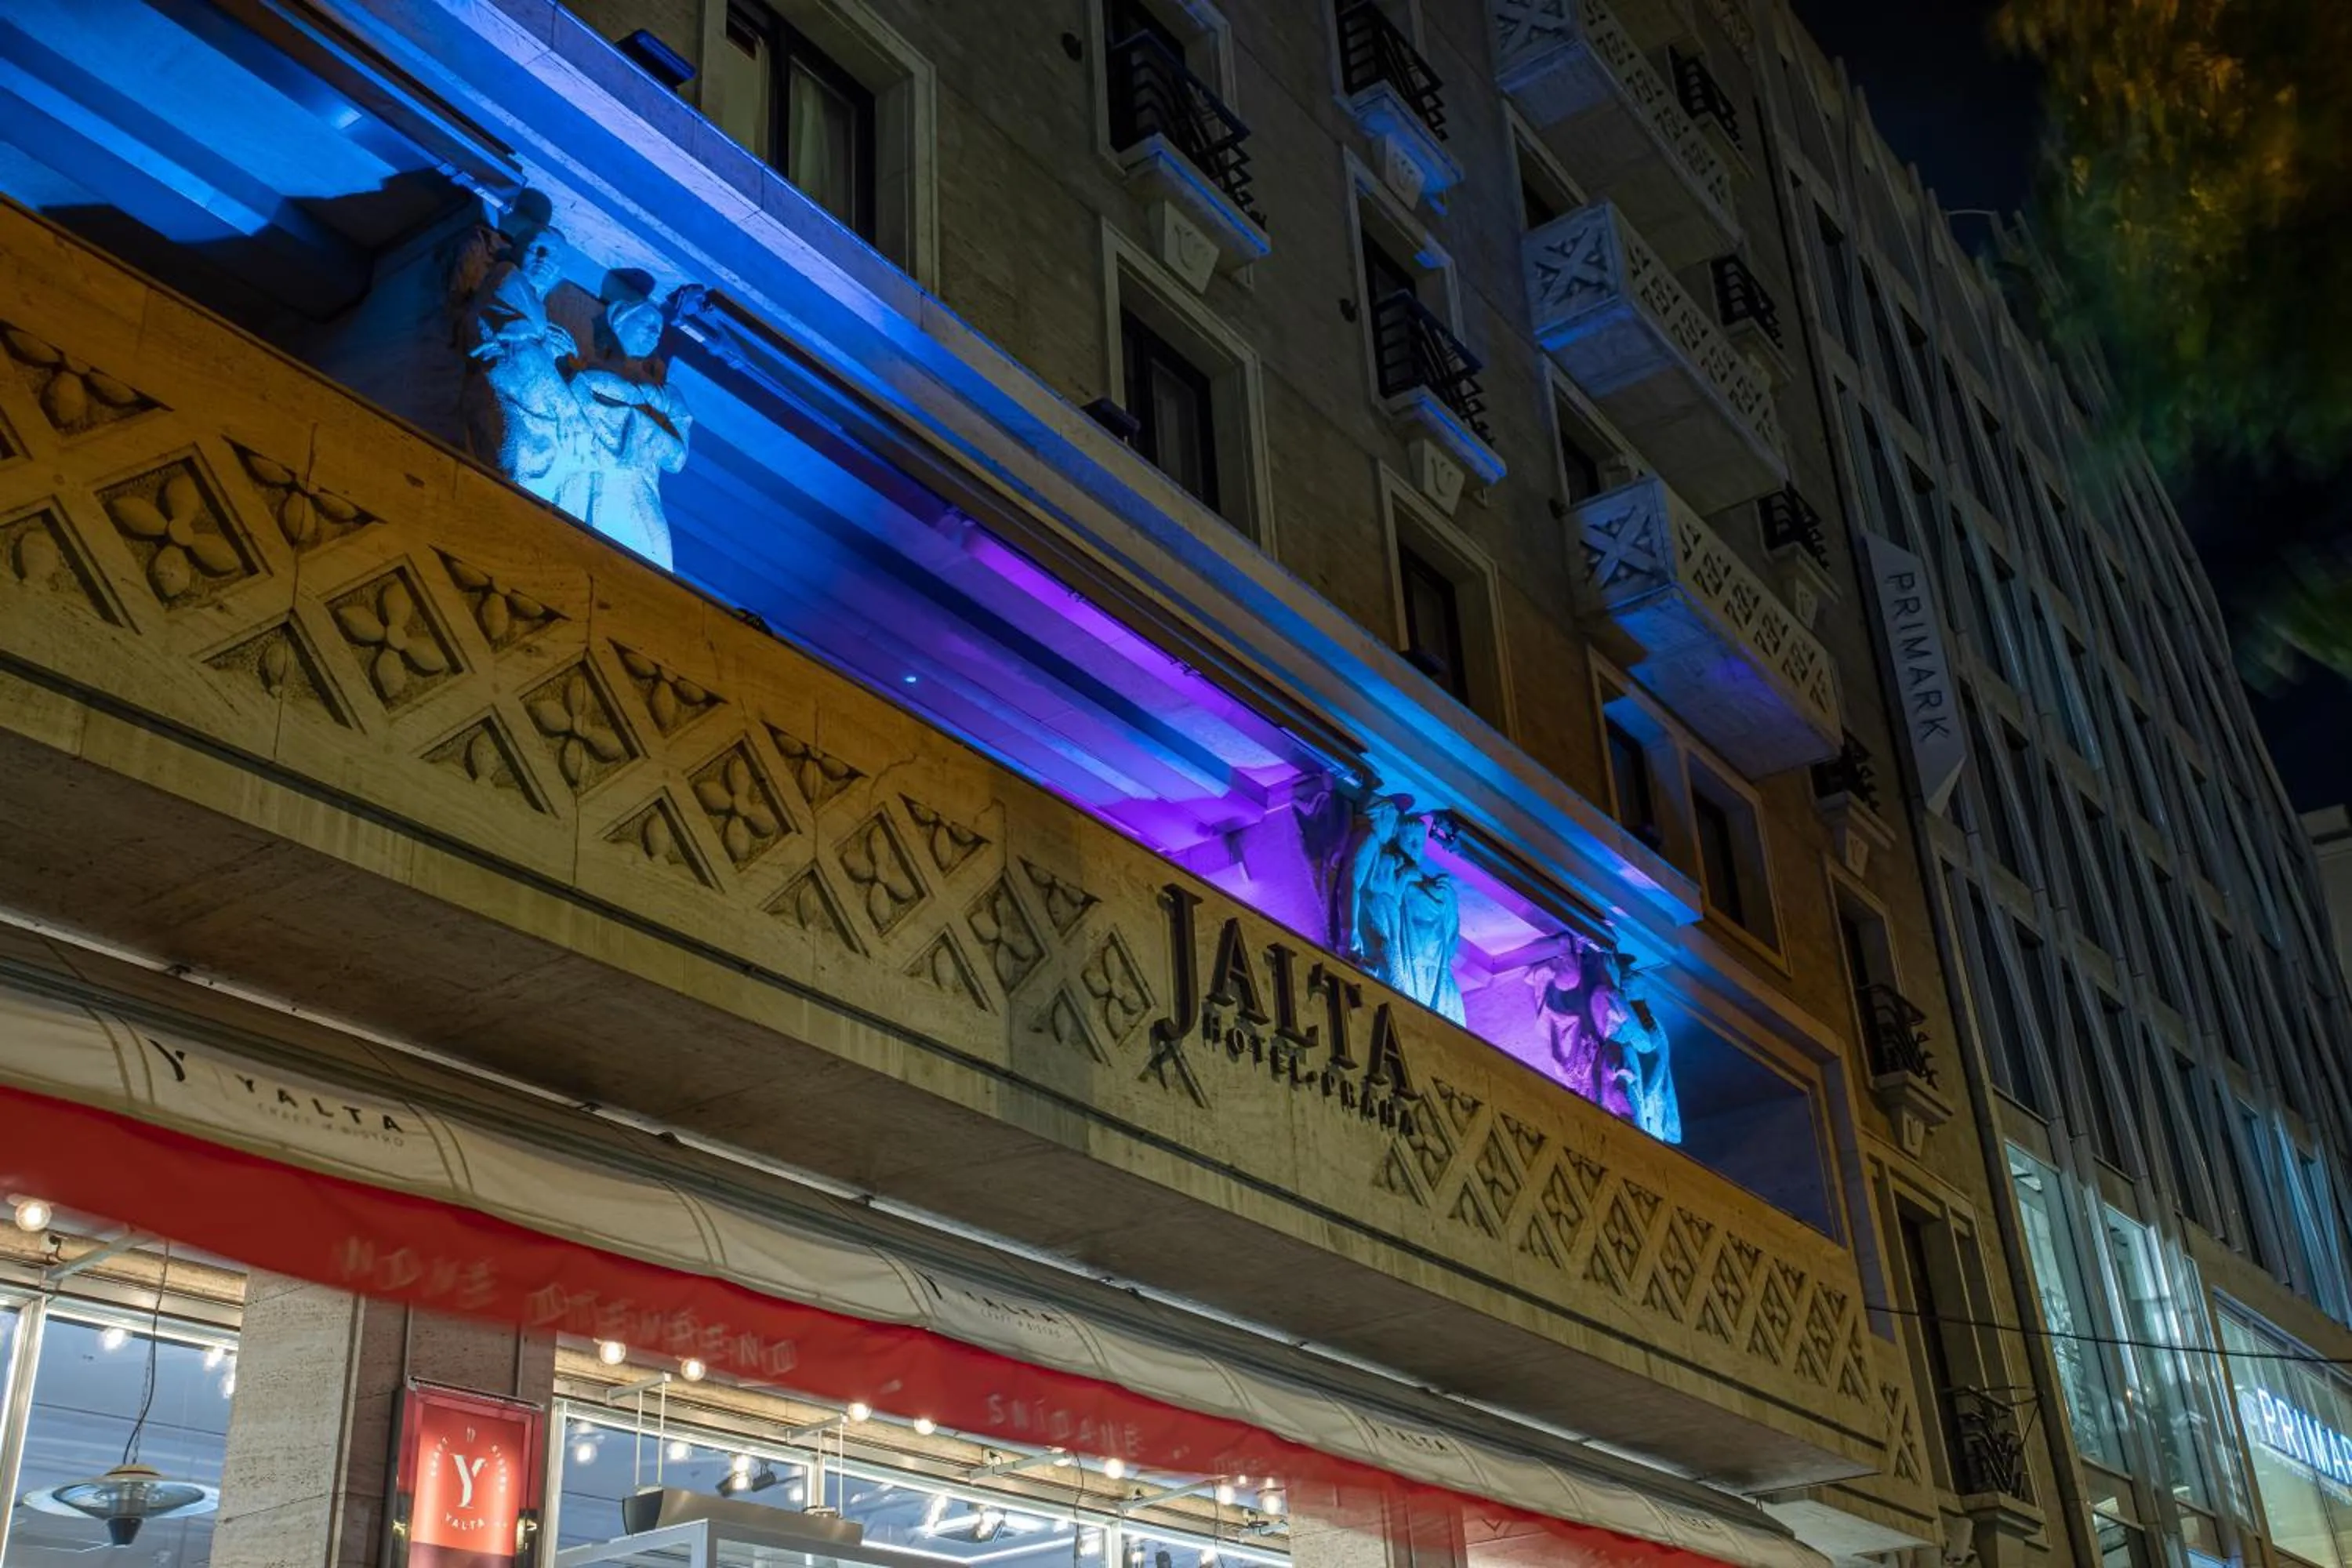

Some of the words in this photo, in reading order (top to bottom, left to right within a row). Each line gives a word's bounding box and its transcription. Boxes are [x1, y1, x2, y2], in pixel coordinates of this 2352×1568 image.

[1885, 571, 1950, 743] PRIMARK
[1149, 882, 1424, 1101] JALTA
[1202, 1007, 1302, 1084] HOTEL
[236, 1073, 404, 1134] YALTA
[450, 1454, 487, 1508] Y
[445, 1512, 486, 1530] YALTA
